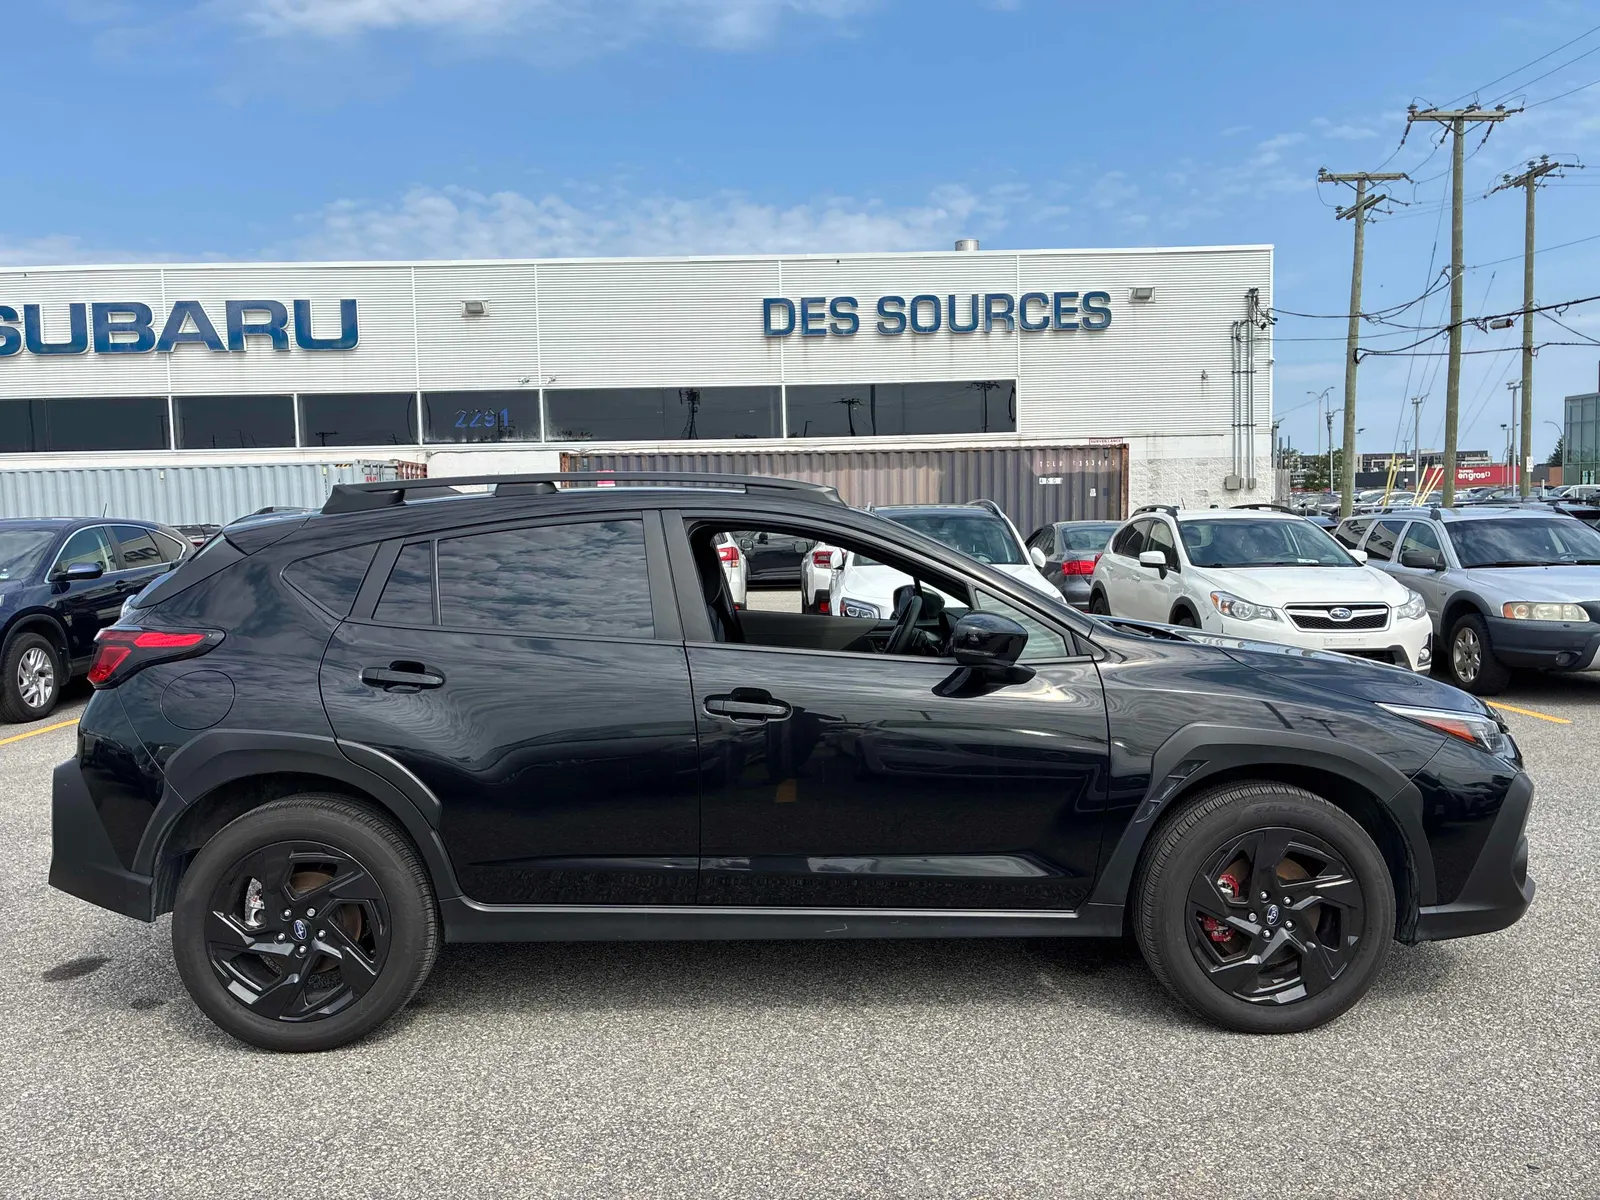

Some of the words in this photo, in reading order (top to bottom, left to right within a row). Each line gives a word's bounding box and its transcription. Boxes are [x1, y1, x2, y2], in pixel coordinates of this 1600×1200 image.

[762, 296, 860, 338] DES
[876, 290, 1112, 337] SOURCES
[454, 407, 509, 428] 2291
